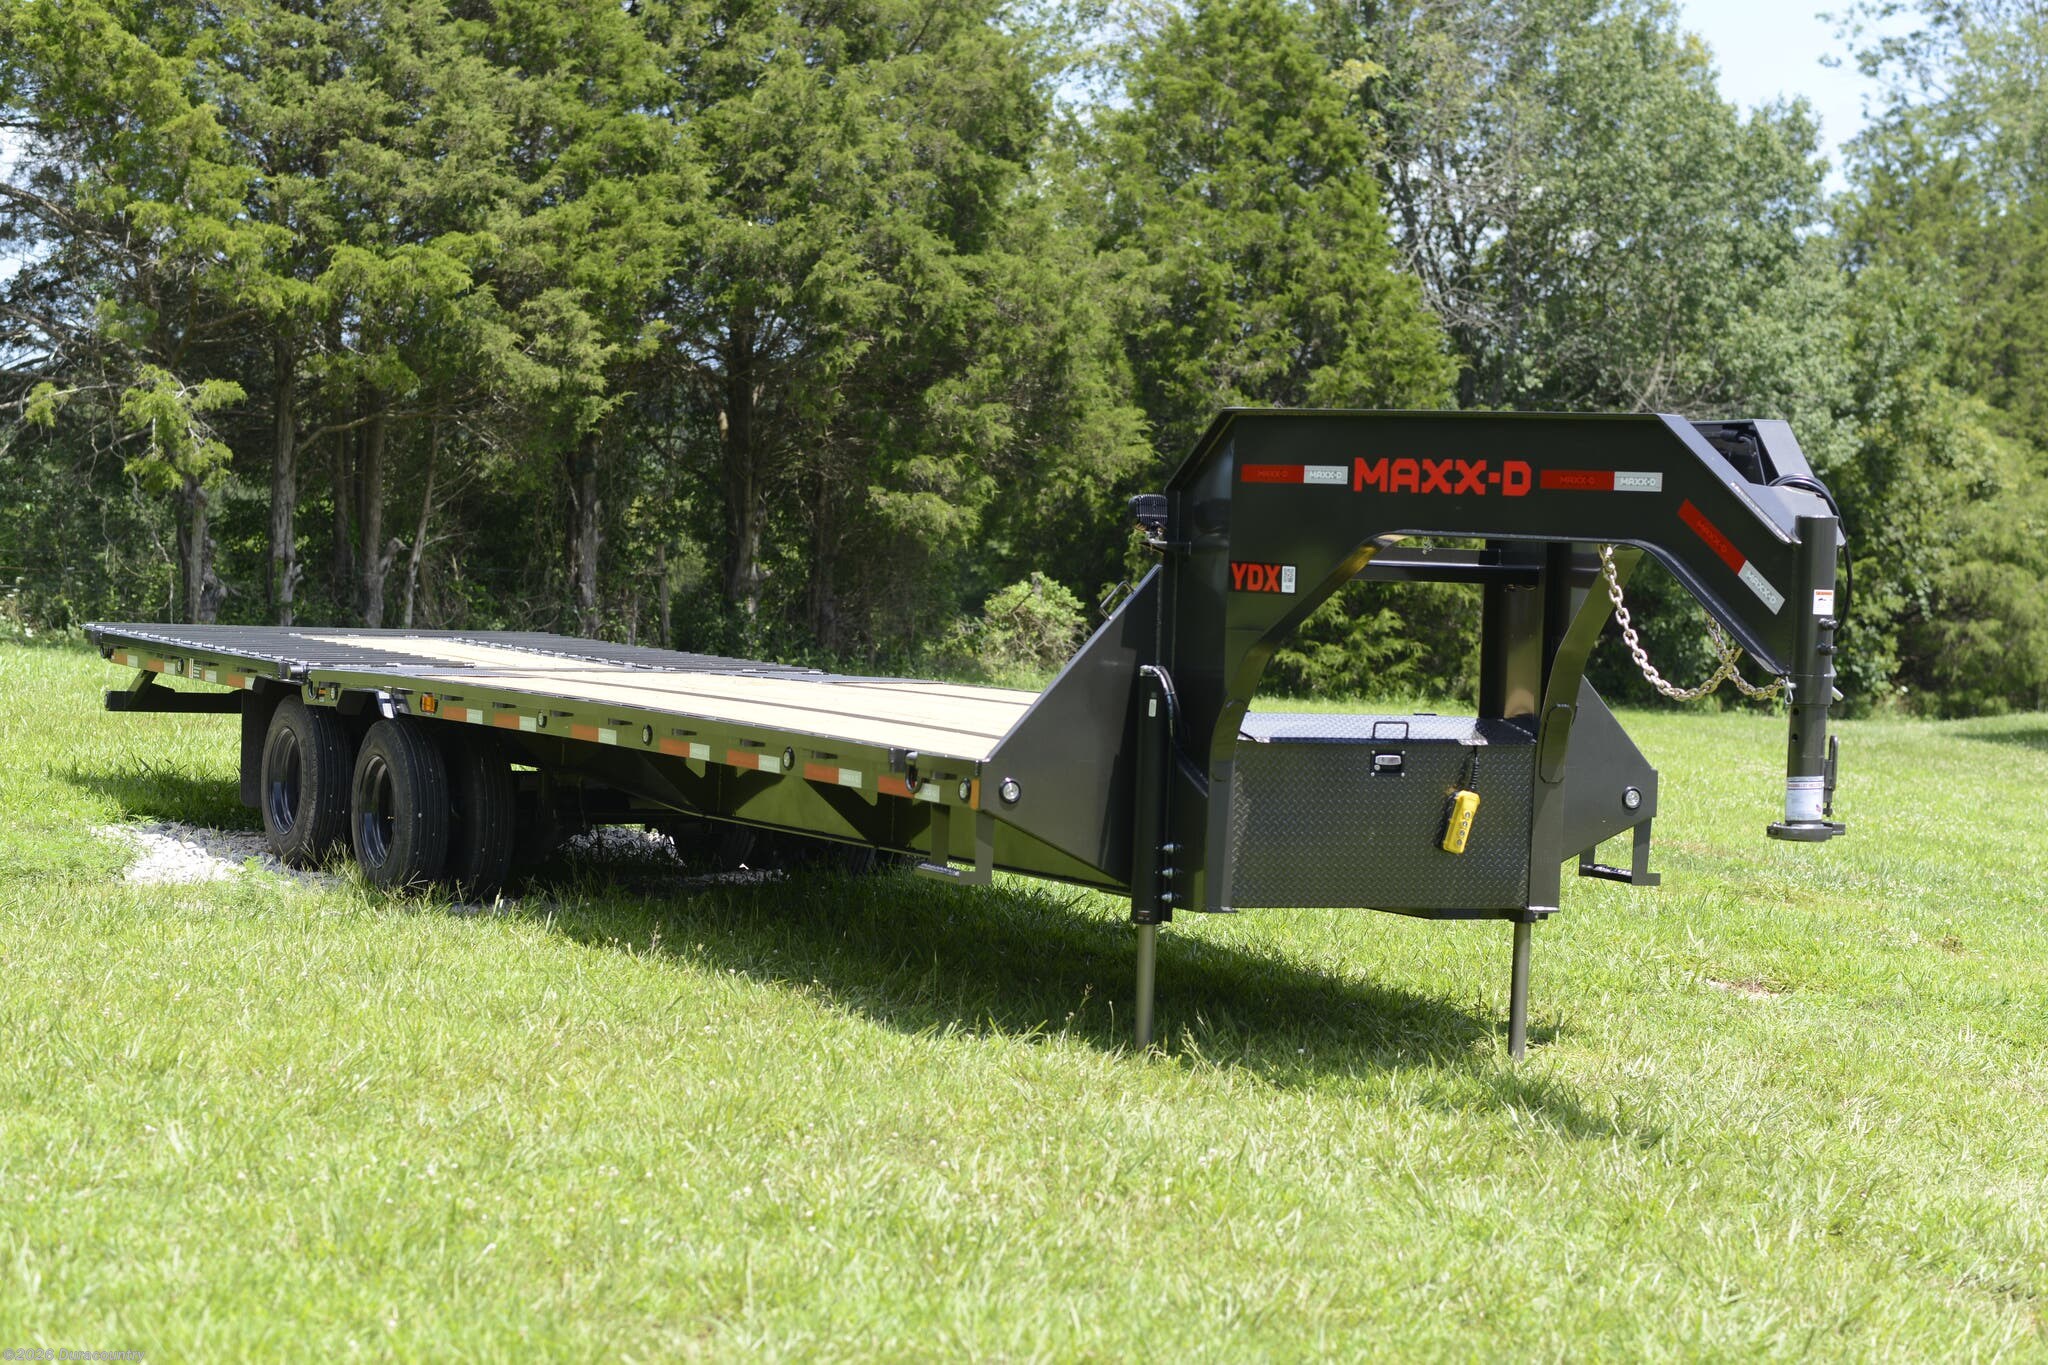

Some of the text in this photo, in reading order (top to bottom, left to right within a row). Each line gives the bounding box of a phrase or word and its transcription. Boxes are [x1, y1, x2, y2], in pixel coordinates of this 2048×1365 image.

[1309, 470, 1343, 479] MAXX-D
[1353, 457, 1532, 496] MAXX-D
[1619, 477, 1657, 487] MAXX-D
[1231, 562, 1281, 593] YDX
[1745, 570, 1777, 604] MAXX-D
